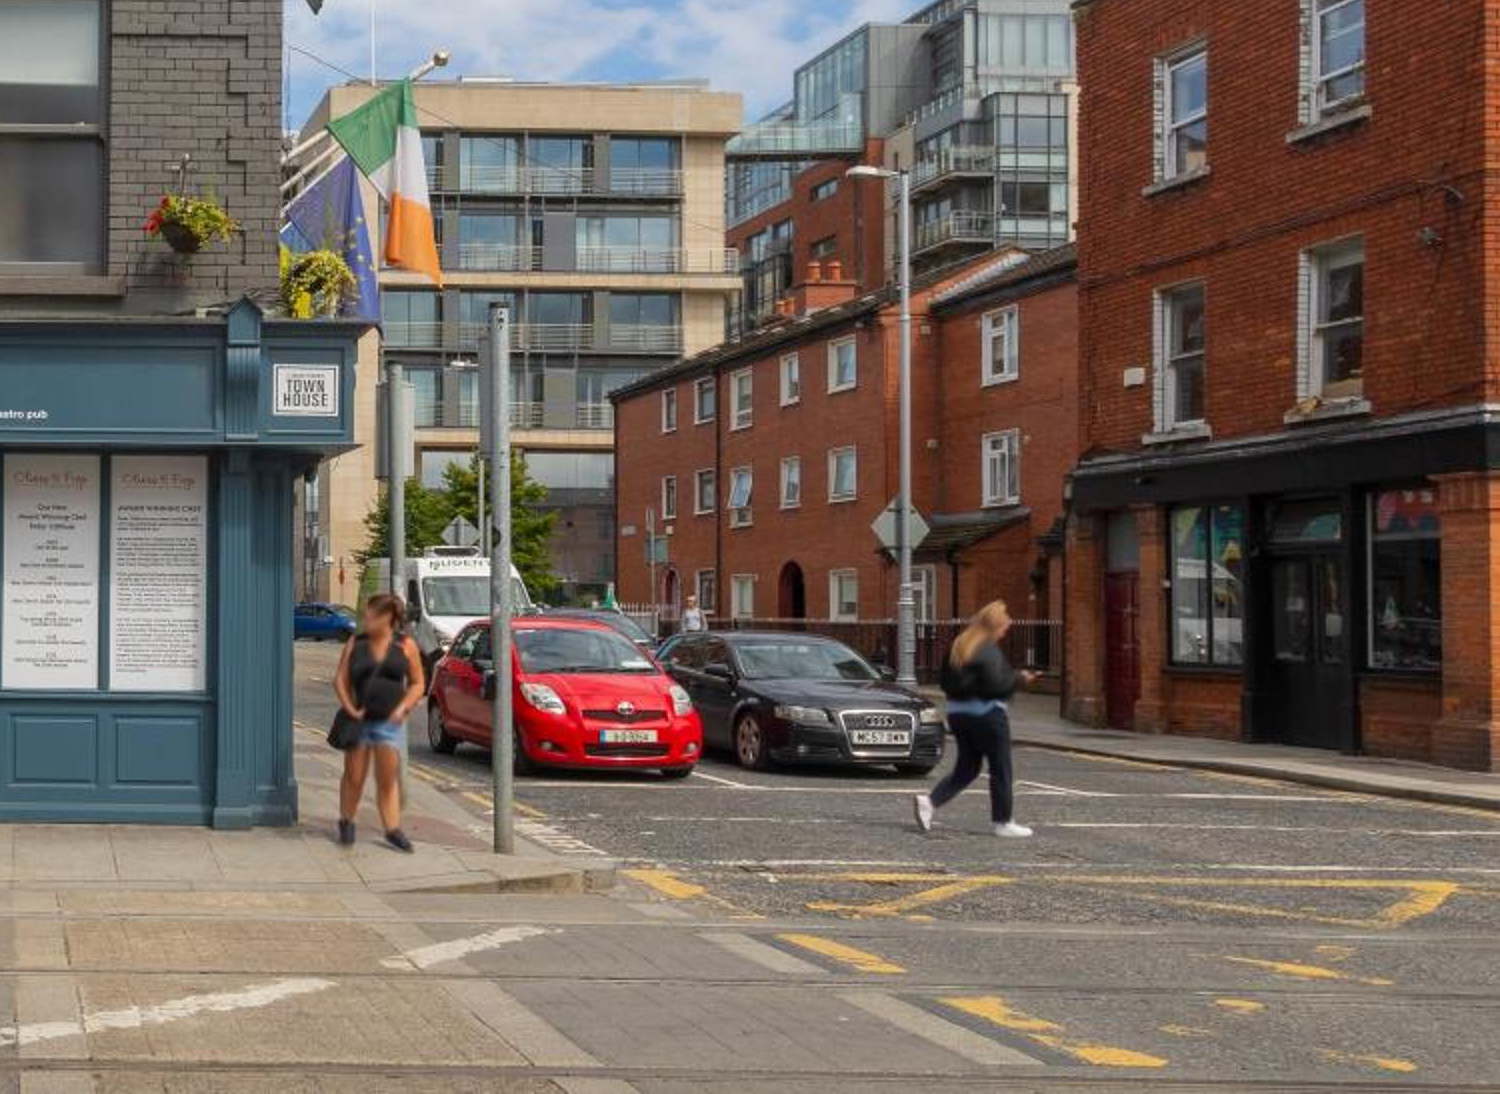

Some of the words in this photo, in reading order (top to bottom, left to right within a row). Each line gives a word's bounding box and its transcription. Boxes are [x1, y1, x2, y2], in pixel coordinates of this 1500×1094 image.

[286, 379, 325, 393] TOWN
[283, 393, 329, 407] HOUSE
[27, 408, 48, 420] pub
